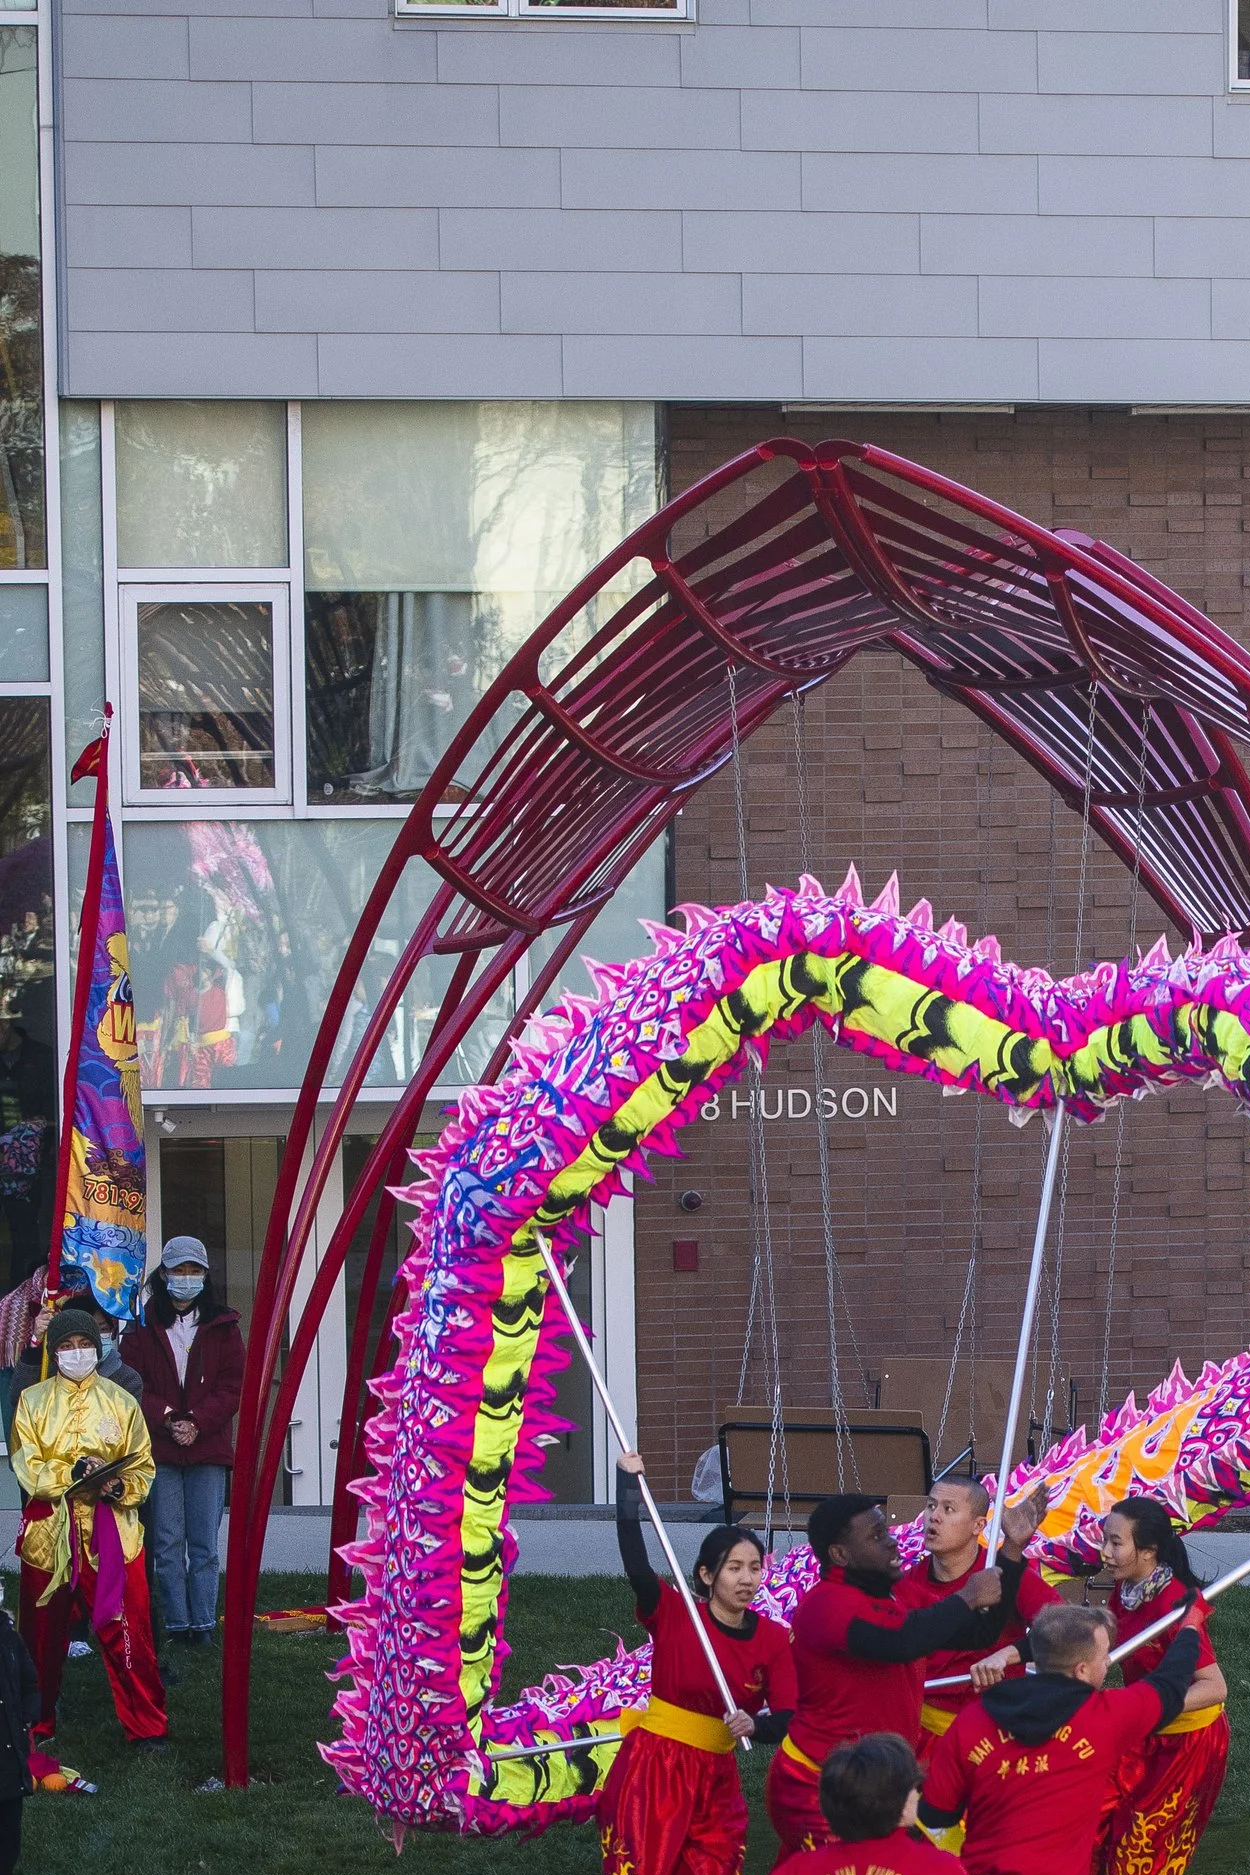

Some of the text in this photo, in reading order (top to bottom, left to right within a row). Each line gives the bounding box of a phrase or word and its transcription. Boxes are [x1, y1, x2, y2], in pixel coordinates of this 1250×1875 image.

[731, 1086, 898, 1121] HUDSON
[967, 1736, 995, 1766] WAH
[1072, 1737, 1096, 1760] FU
